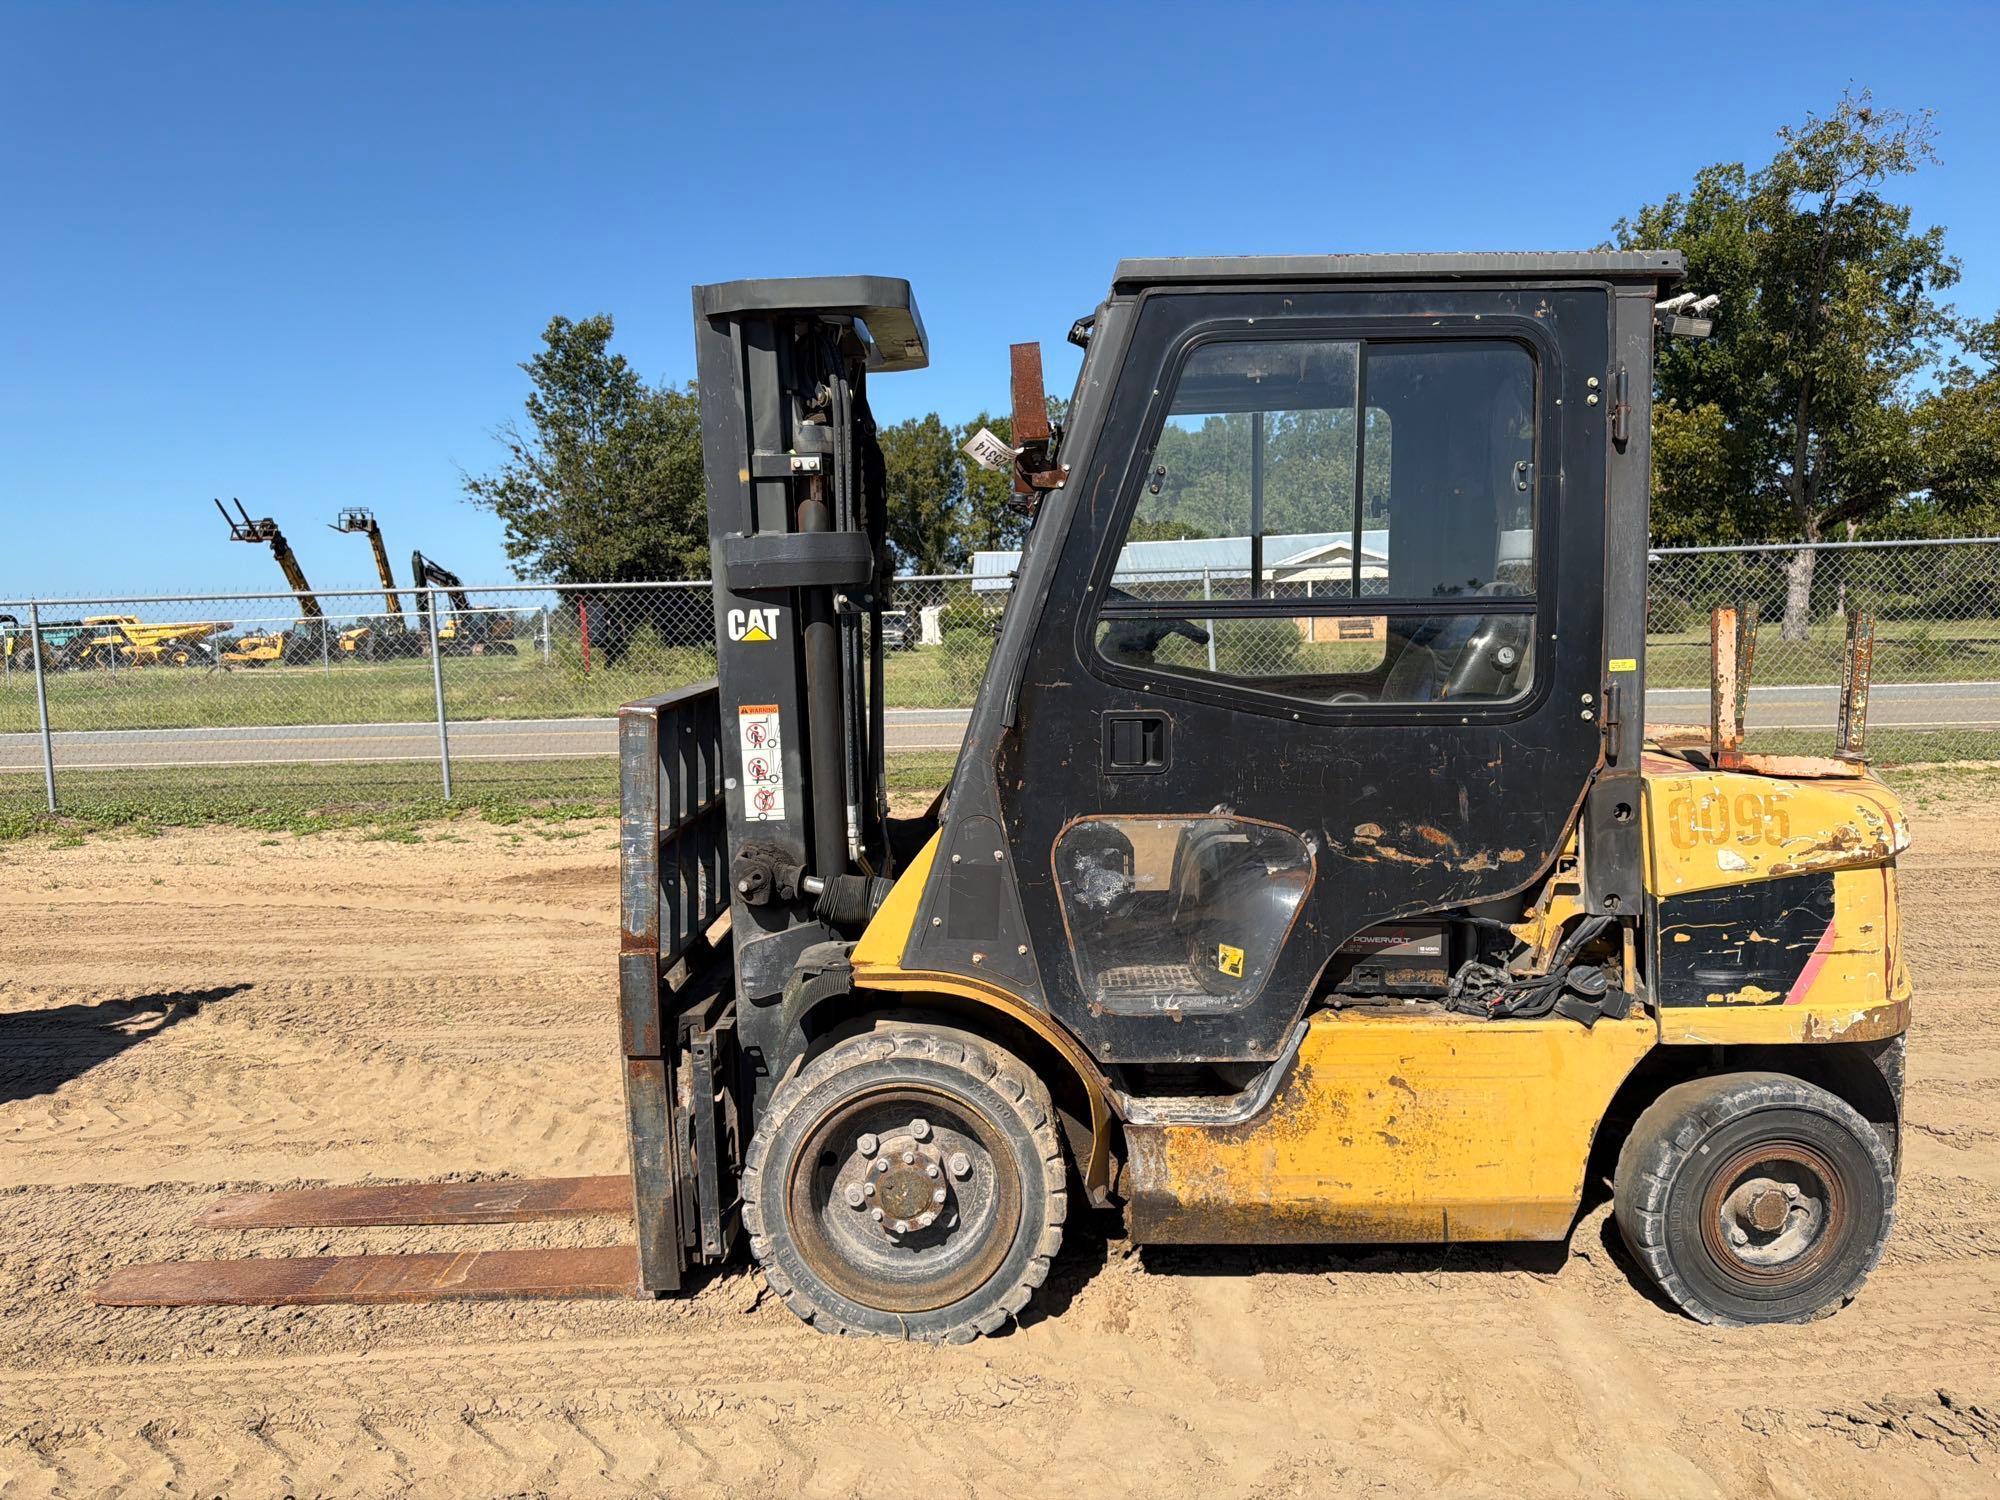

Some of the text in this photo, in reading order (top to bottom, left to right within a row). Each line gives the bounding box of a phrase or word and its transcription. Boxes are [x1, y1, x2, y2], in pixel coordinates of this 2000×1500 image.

[974, 441, 1007, 467] 25314
[728, 608, 780, 641] CAT
[749, 706, 778, 714] WARNING
[1669, 793, 1790, 850] 0095
[1353, 936, 1411, 944] POWERVOLT
[779, 1246, 866, 1327] TRELLEBORG
